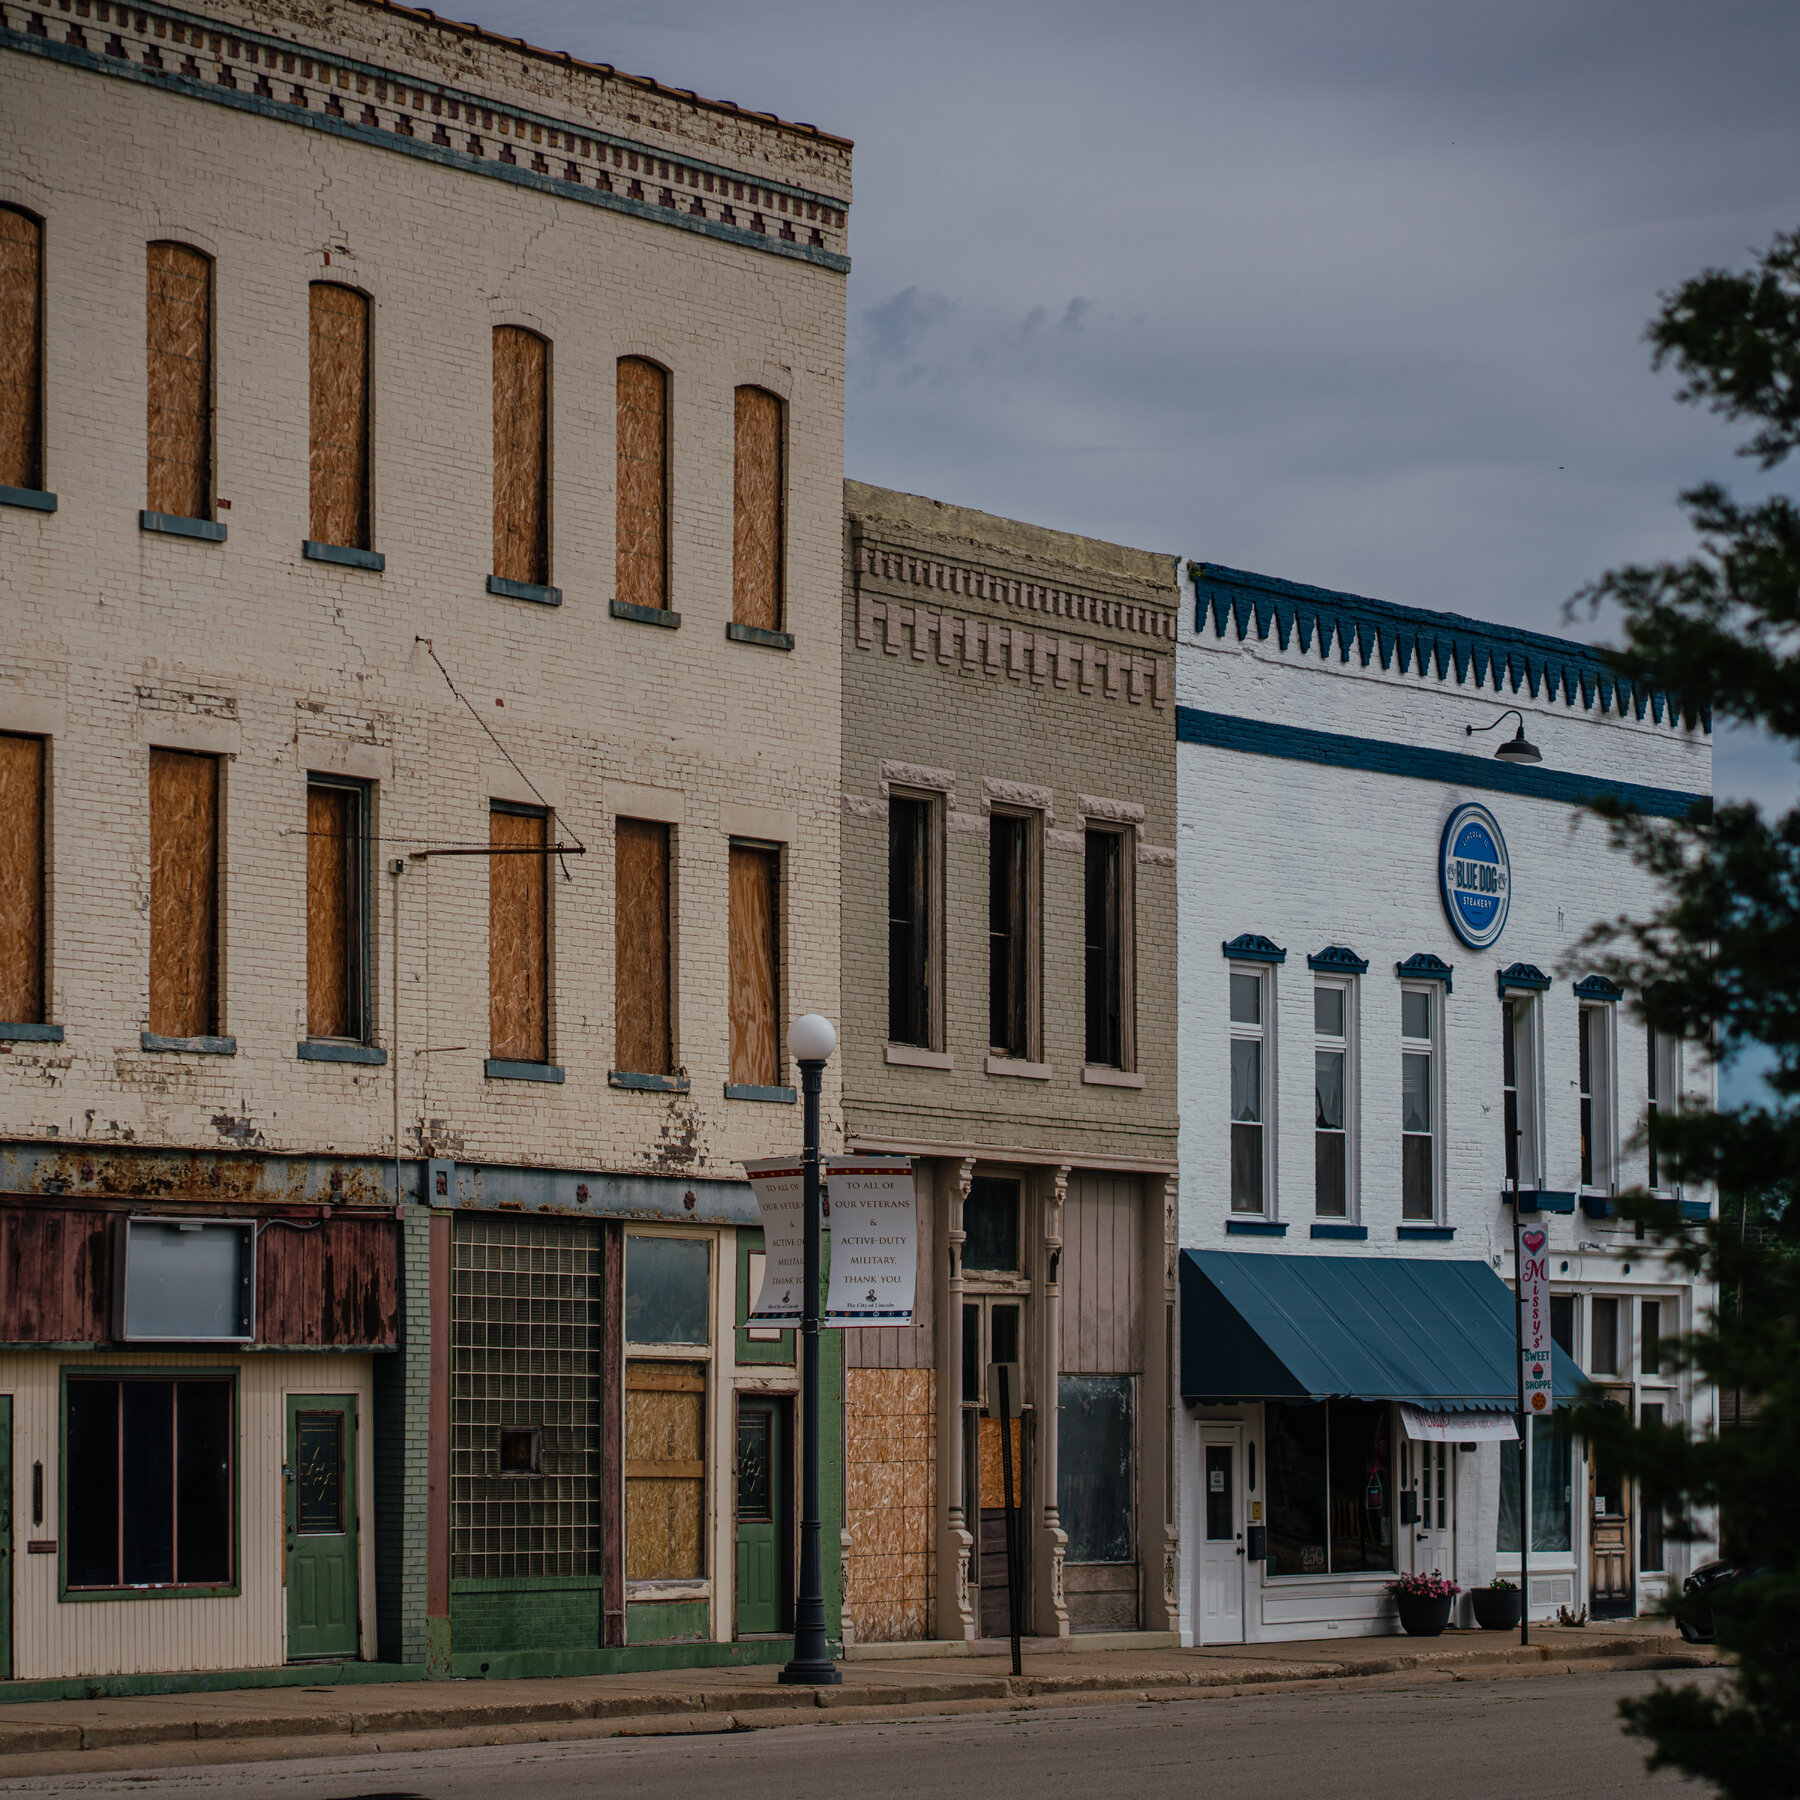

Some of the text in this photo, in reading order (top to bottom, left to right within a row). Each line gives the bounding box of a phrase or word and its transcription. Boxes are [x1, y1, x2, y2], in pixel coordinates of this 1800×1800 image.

[1456, 860, 1497, 894] BLUE DOG
[1463, 896, 1492, 909] STEAKERY
[766, 1183, 799, 1192] TO ALL OF
[847, 1181, 895, 1190] TO ALL OF
[763, 1201, 805, 1211] OUR VETER
[835, 1200, 910, 1208] OUR VETERANS
[870, 1218, 877, 1226] &
[772, 1238, 805, 1247] ACTIVE-D
[841, 1236, 907, 1245] ACTIVE-DUTY
[778, 1257, 804, 1266] MILITAR
[772, 1277, 793, 1285] THANK
[844, 1275, 877, 1283] THANK
[1525, 1351, 1550, 1362] SWEET
[1525, 1380, 1552, 1390] SHOPPE
[1300, 1546, 1324, 1566] 250
